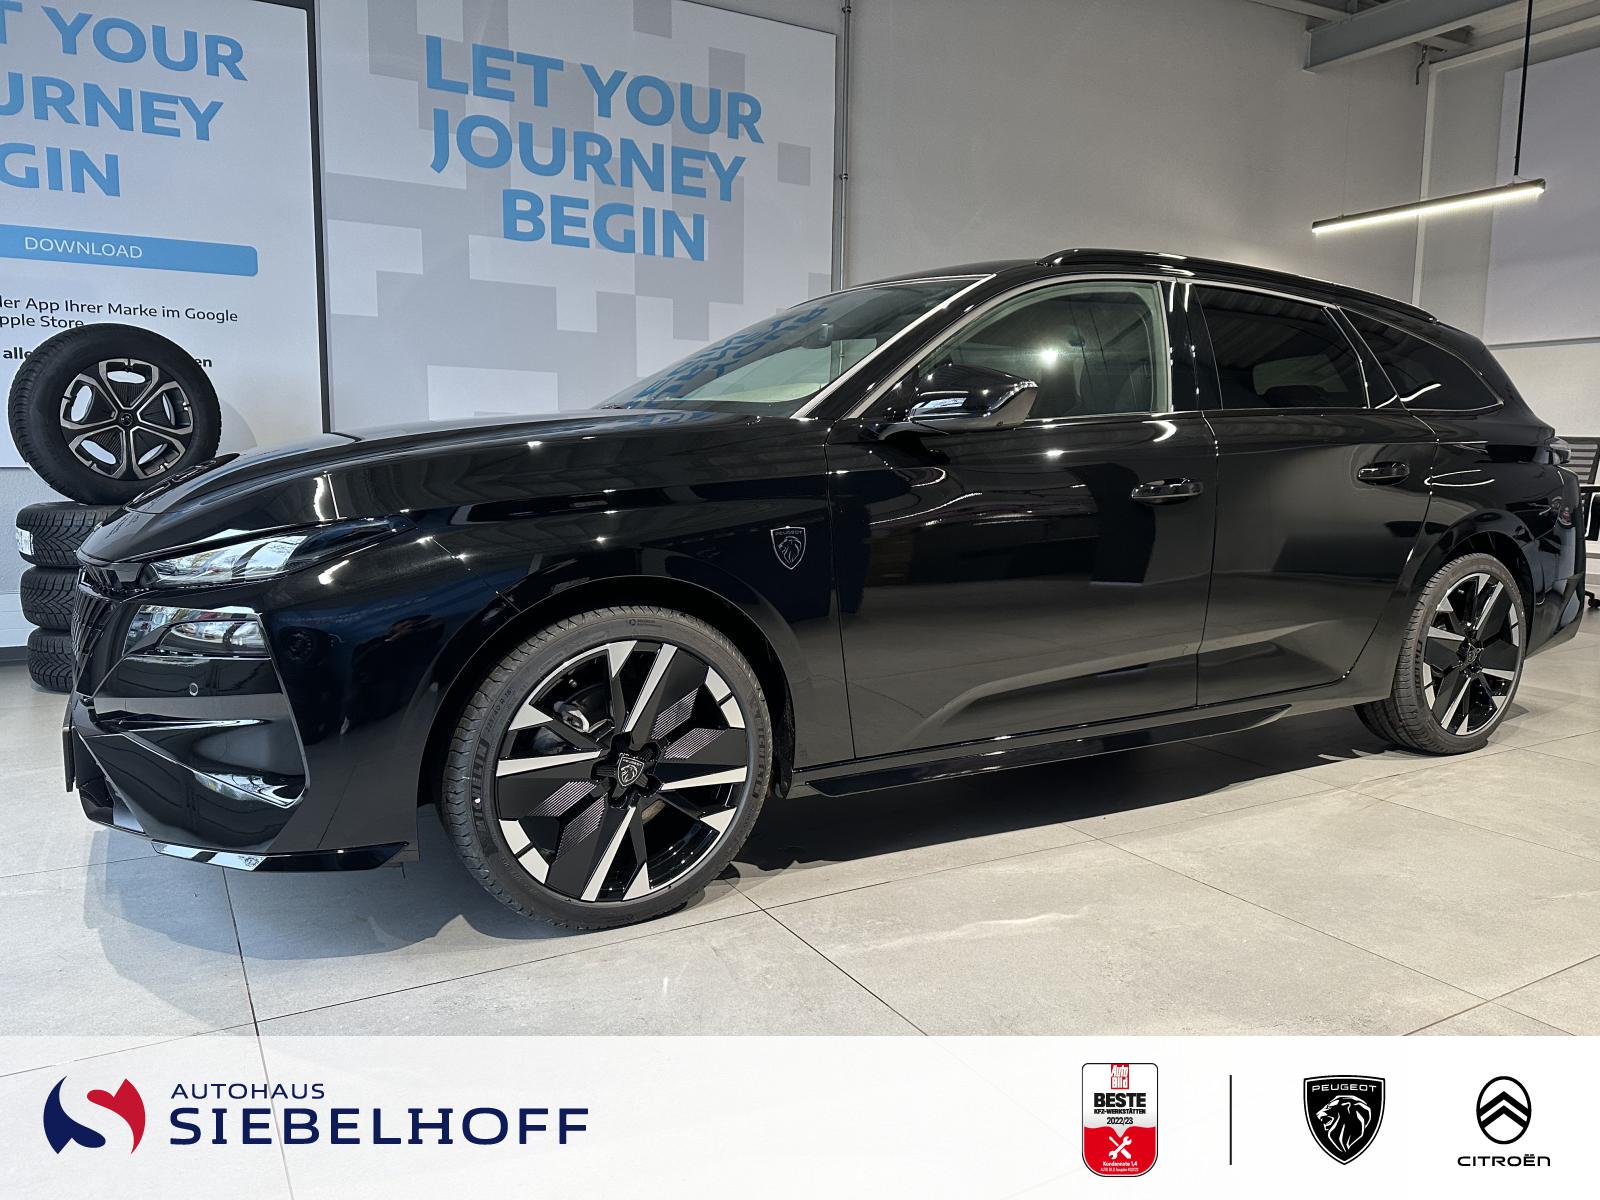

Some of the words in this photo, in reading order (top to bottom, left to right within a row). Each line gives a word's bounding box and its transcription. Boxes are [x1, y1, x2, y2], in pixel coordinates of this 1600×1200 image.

[43, 7, 248, 81] YOUR
[426, 35, 564, 108] LET
[581, 63, 764, 144] YOUR
[0, 142, 121, 197] GIN
[430, 108, 746, 202] JOURNEY
[24, 237, 143, 260] DOWNLOAD
[502, 189, 705, 262] BEGIN
[25, 298, 59, 313] App
[65, 300, 103, 314] Ihrer
[108, 303, 157, 318] Marke
[162, 305, 180, 319] im
[185, 308, 239, 324] Google
[40, 316, 85, 330] Store
